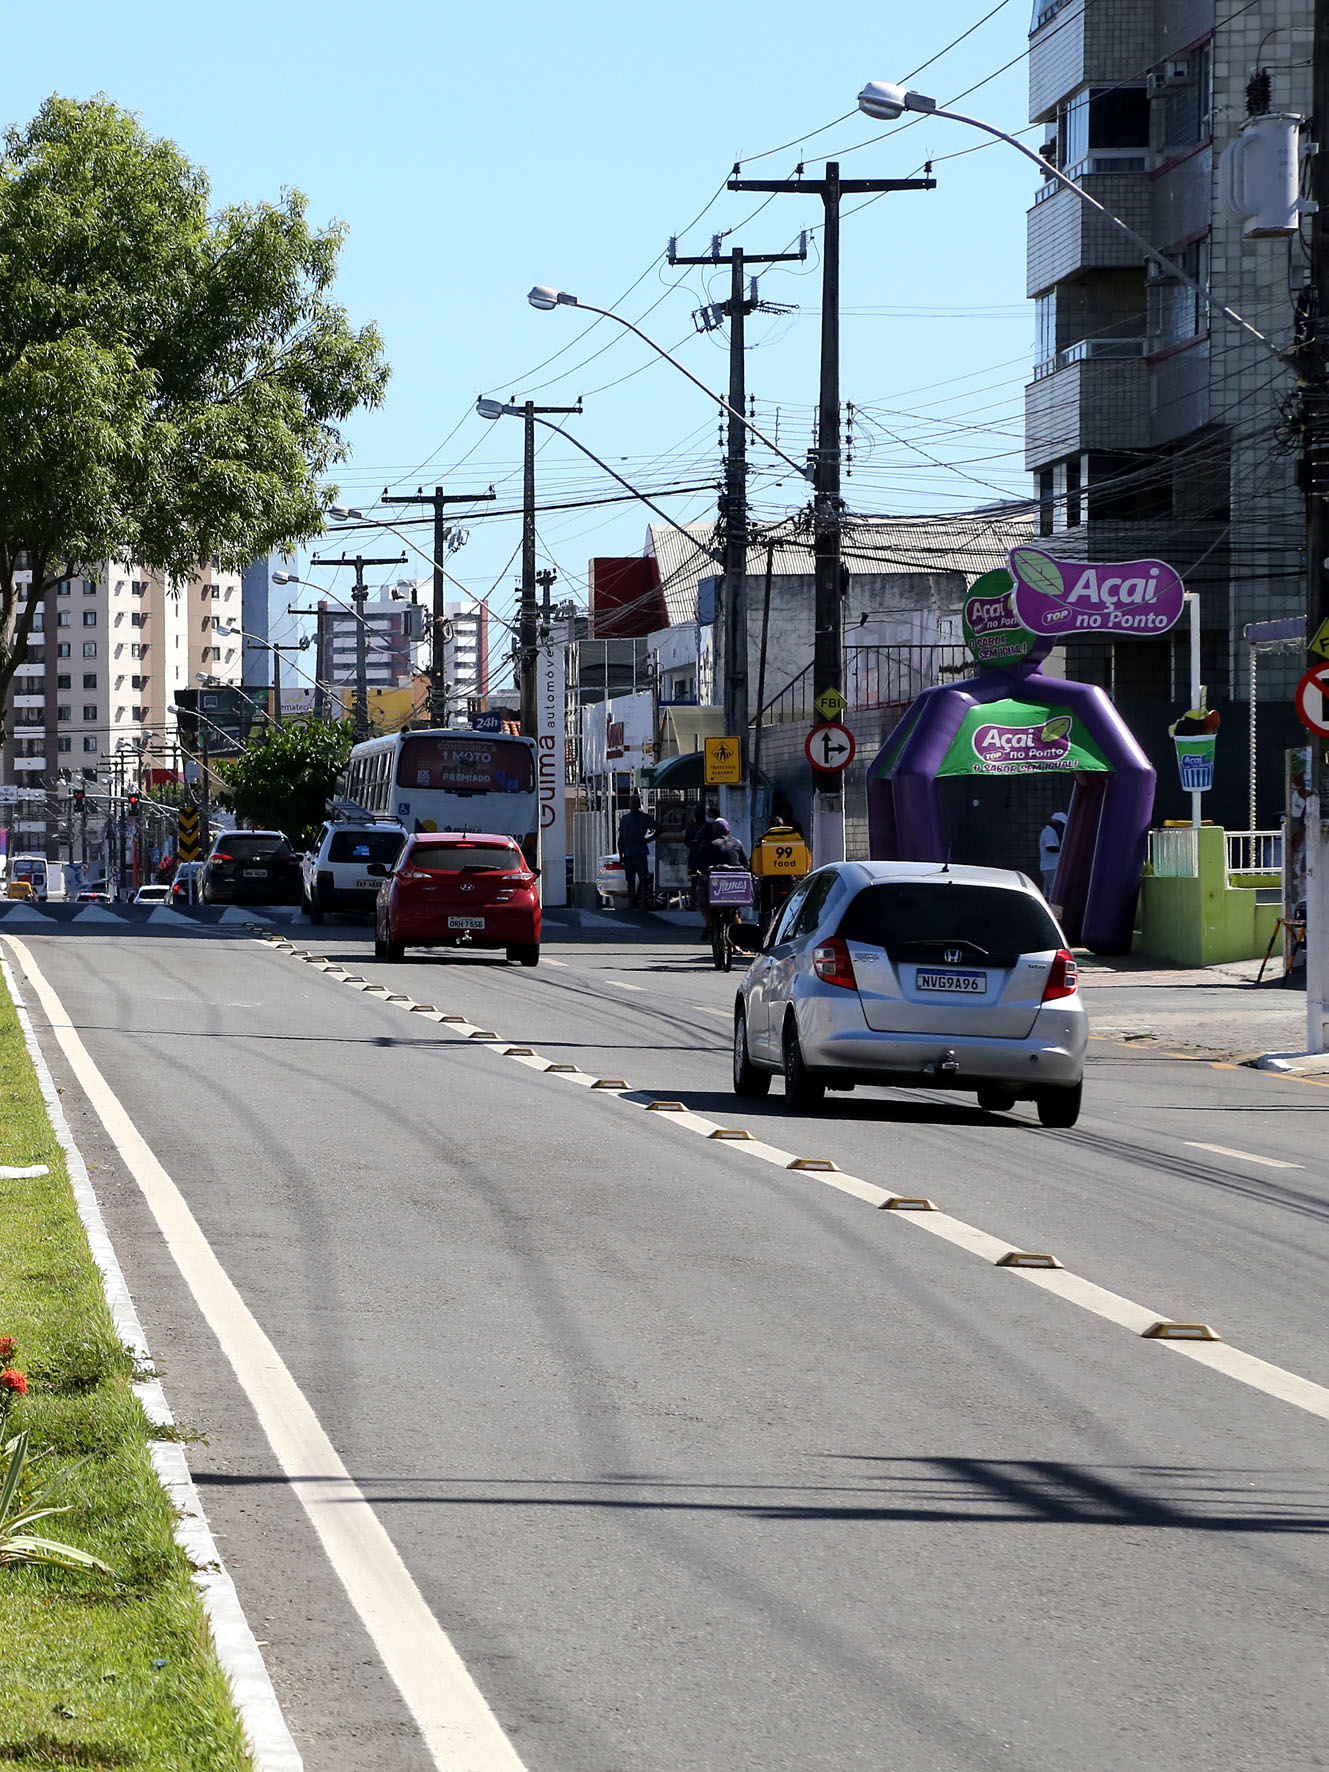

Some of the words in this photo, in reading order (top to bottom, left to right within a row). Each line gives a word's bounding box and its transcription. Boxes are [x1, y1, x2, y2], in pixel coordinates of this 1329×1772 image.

[1046, 610, 1069, 622] TOP
[1075, 614, 1102, 627] no
[1107, 611, 1168, 627] Ponto
[976, 634, 1007, 648] SABOR
[978, 648, 998, 660] SEM
[820, 697, 841, 708] FBI
[476, 716, 498, 729] 24h
[452, 751, 492, 763] MOTO
[985, 752, 1003, 760] TOP
[1009, 750, 1025, 759] no
[1029, 747, 1064, 758] Ponto
[983, 763, 1019, 773] SABOR
[1019, 763, 1043, 772] SEM
[442, 772, 491, 783] PREMIADO
[775, 846, 793, 859] 99
[713, 880, 747, 896] James
[922, 975, 979, 990] NVG9A96
